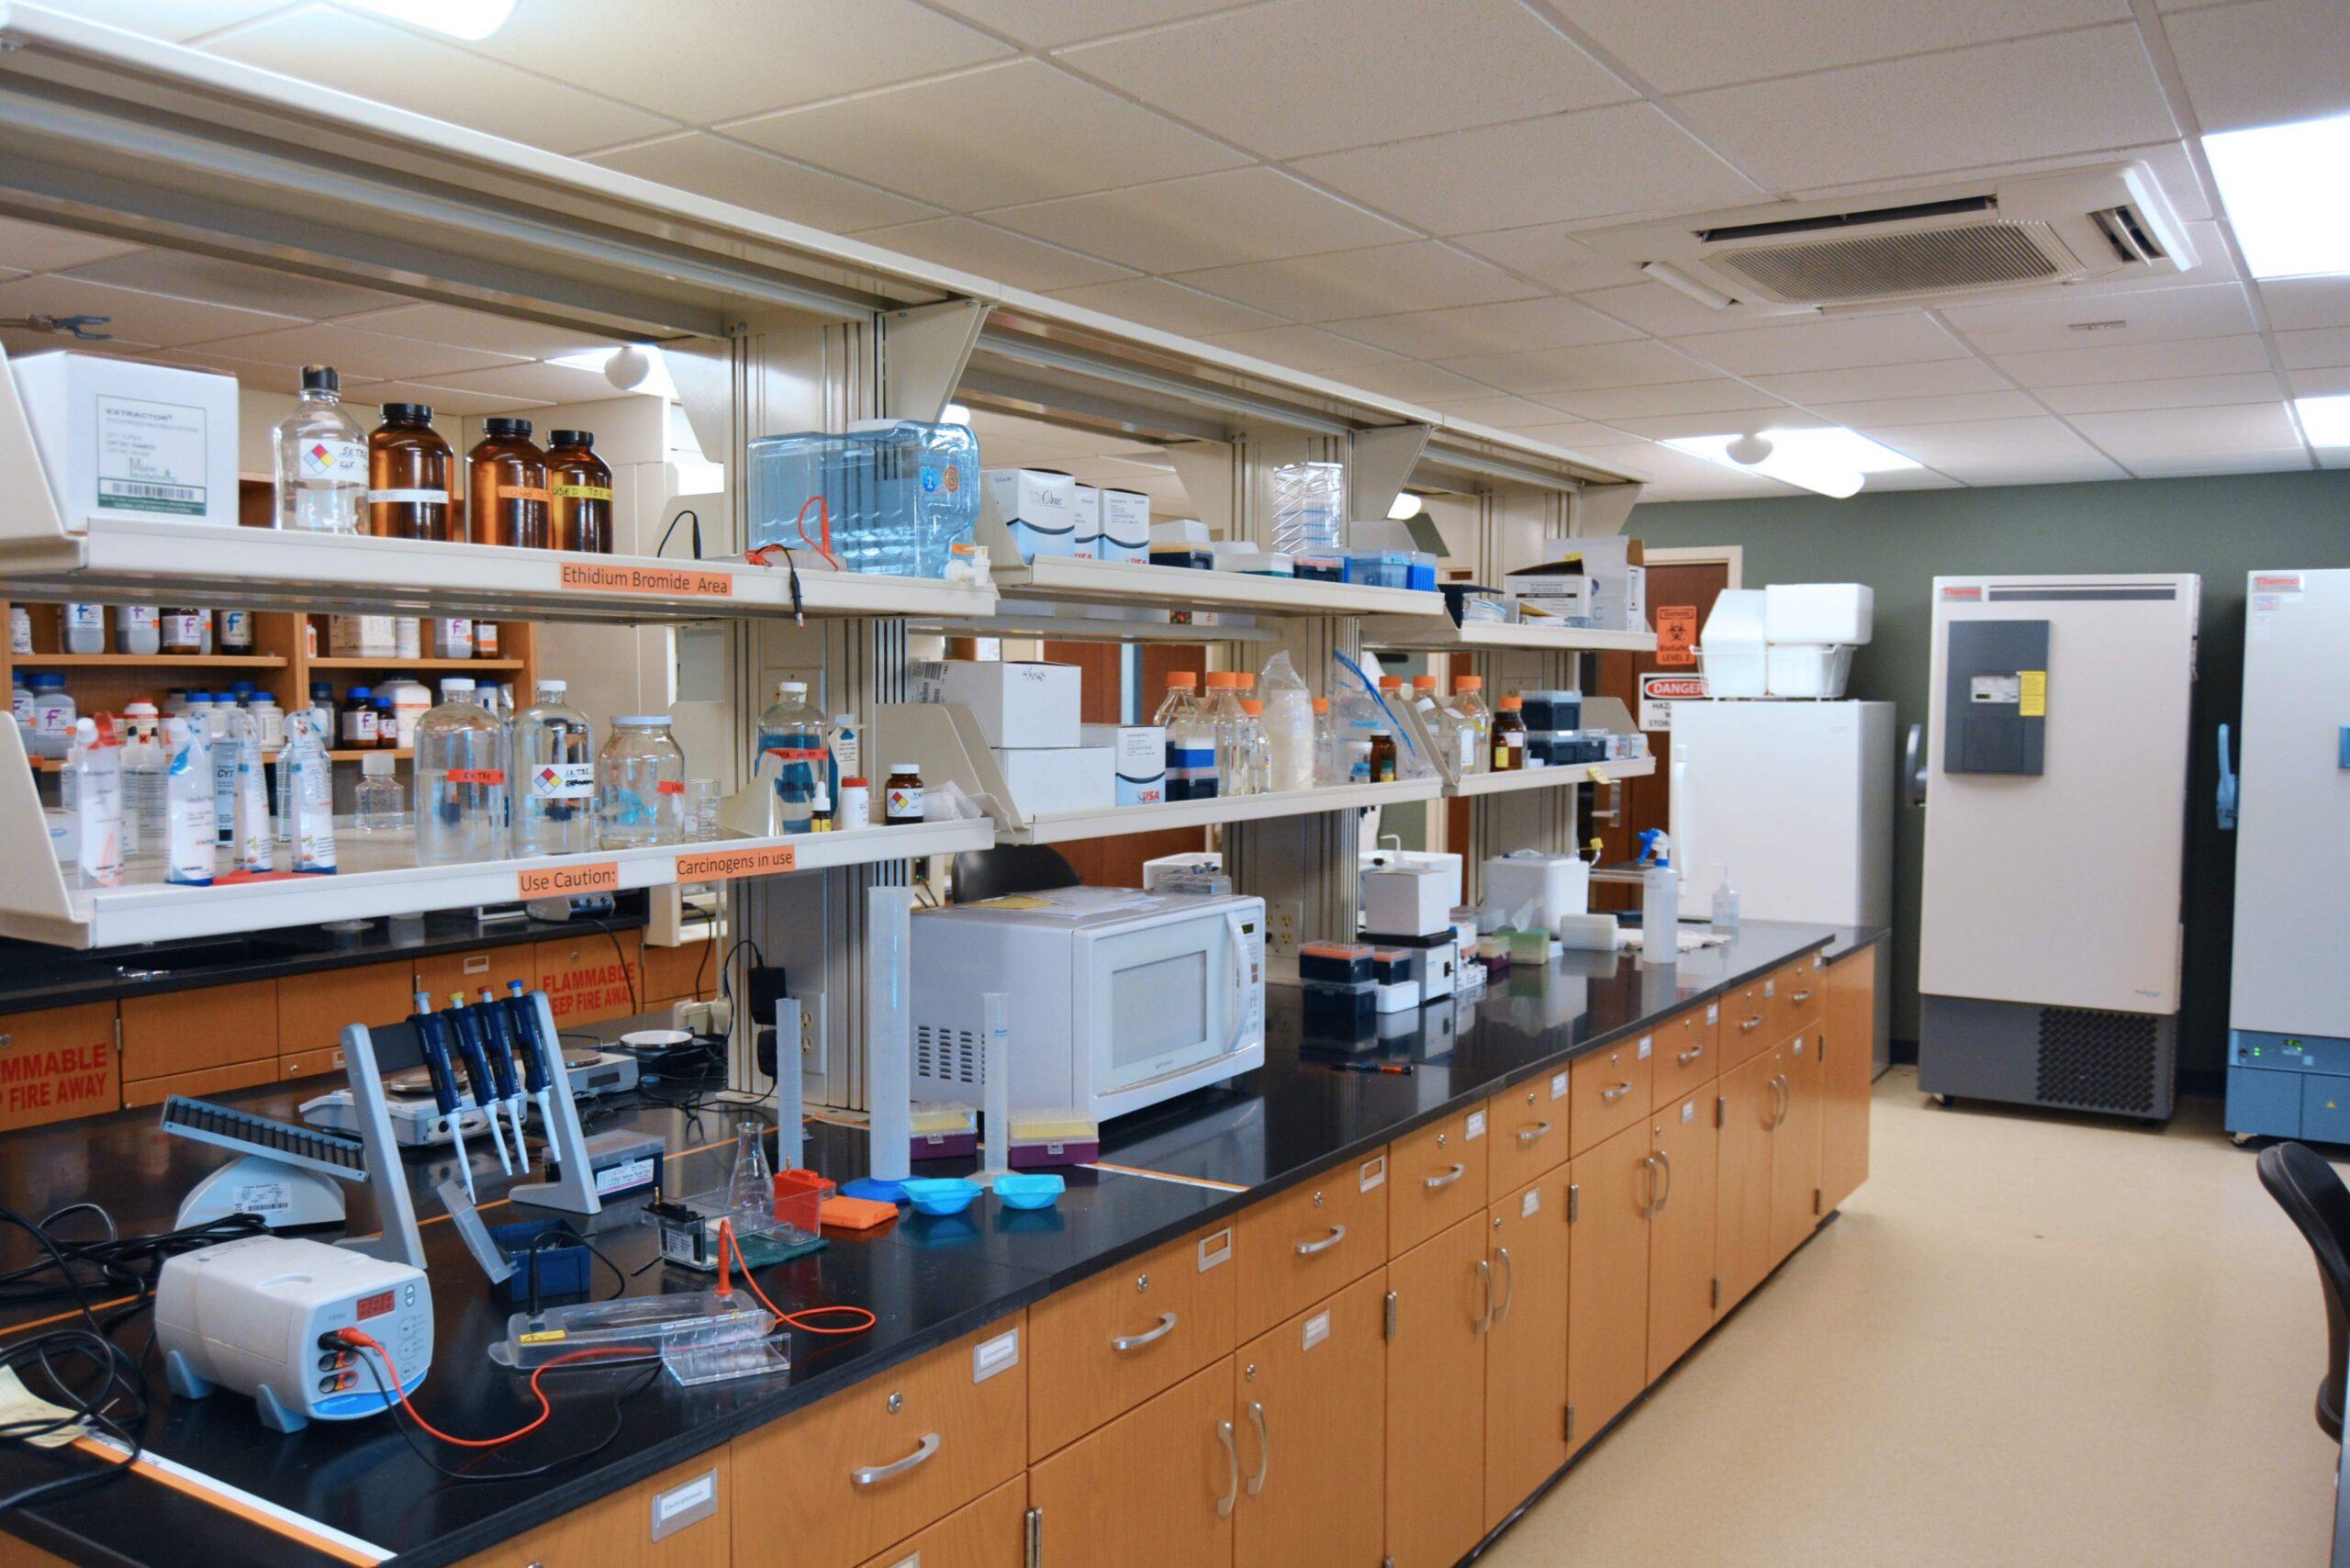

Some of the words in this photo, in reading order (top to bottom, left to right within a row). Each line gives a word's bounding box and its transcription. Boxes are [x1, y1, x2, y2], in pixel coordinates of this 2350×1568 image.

[563, 566, 629, 586] Ethidium
[632, 572, 690, 590] Bromide
[698, 577, 728, 593] Area
[1653, 683, 1704, 694] DANGER
[1143, 790, 1160, 801] USA
[677, 853, 755, 876] Carcinogens
[757, 852, 769, 867] in
[773, 853, 793, 866] use
[520, 874, 550, 892] Use
[554, 868, 616, 888] Caution:
[543, 961, 635, 994] FLAMMABLE
[549, 995, 574, 1016] EEP
[576, 991, 601, 1013] FIRE
[0, 1043, 107, 1083] MMABLE
[9, 1082, 51, 1113] FIRE
[57, 1072, 107, 1103] AWAY
